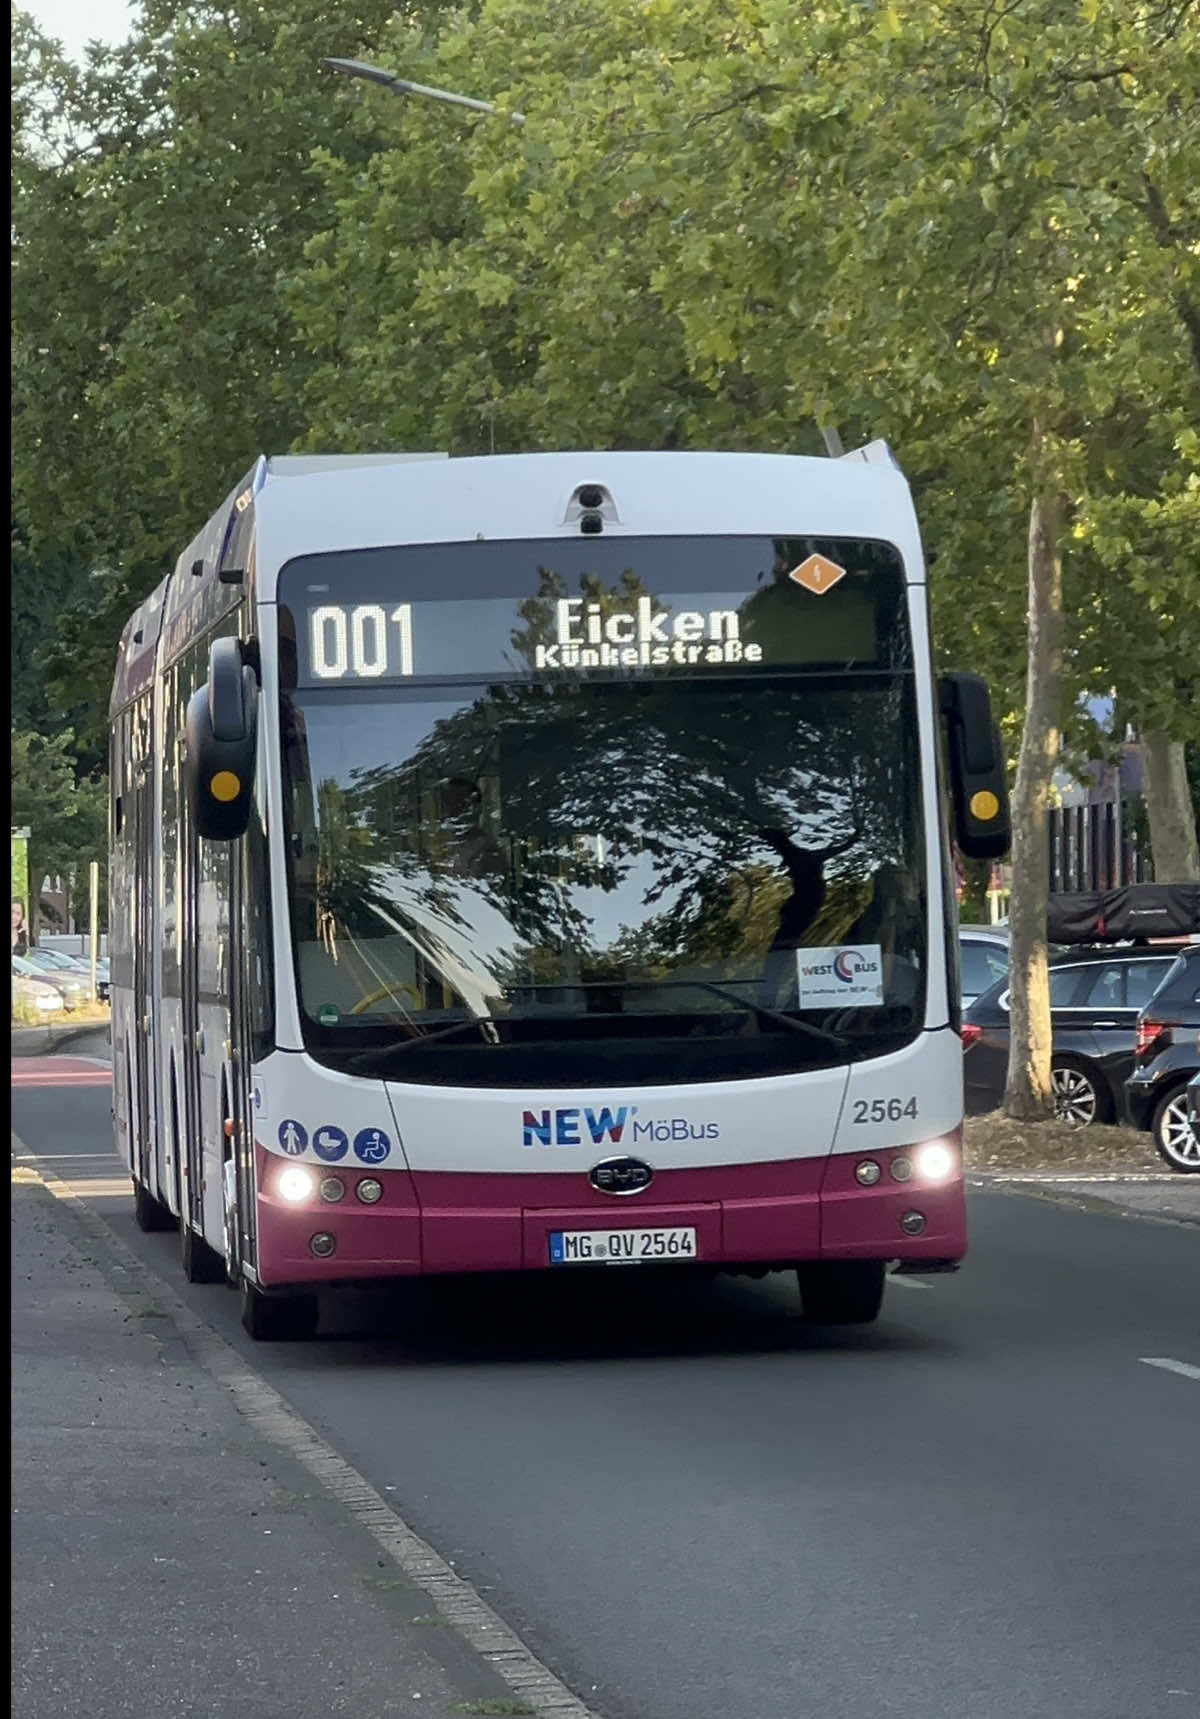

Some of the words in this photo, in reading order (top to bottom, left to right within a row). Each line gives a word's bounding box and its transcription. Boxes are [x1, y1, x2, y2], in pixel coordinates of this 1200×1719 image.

[557, 597, 740, 644] Eicken
[311, 603, 414, 679] 001
[535, 639, 763, 668] Künkelstraße
[802, 965, 833, 976] WEST
[854, 962, 878, 973] BUS
[853, 1096, 919, 1123] 2564
[522, 1107, 629, 1146] NEW
[633, 1119, 720, 1142] MöBus
[596, 1168, 650, 1184] BYD
[565, 1235, 592, 1258] MG
[608, 1234, 635, 1257] QV
[641, 1231, 693, 1255] 2564
